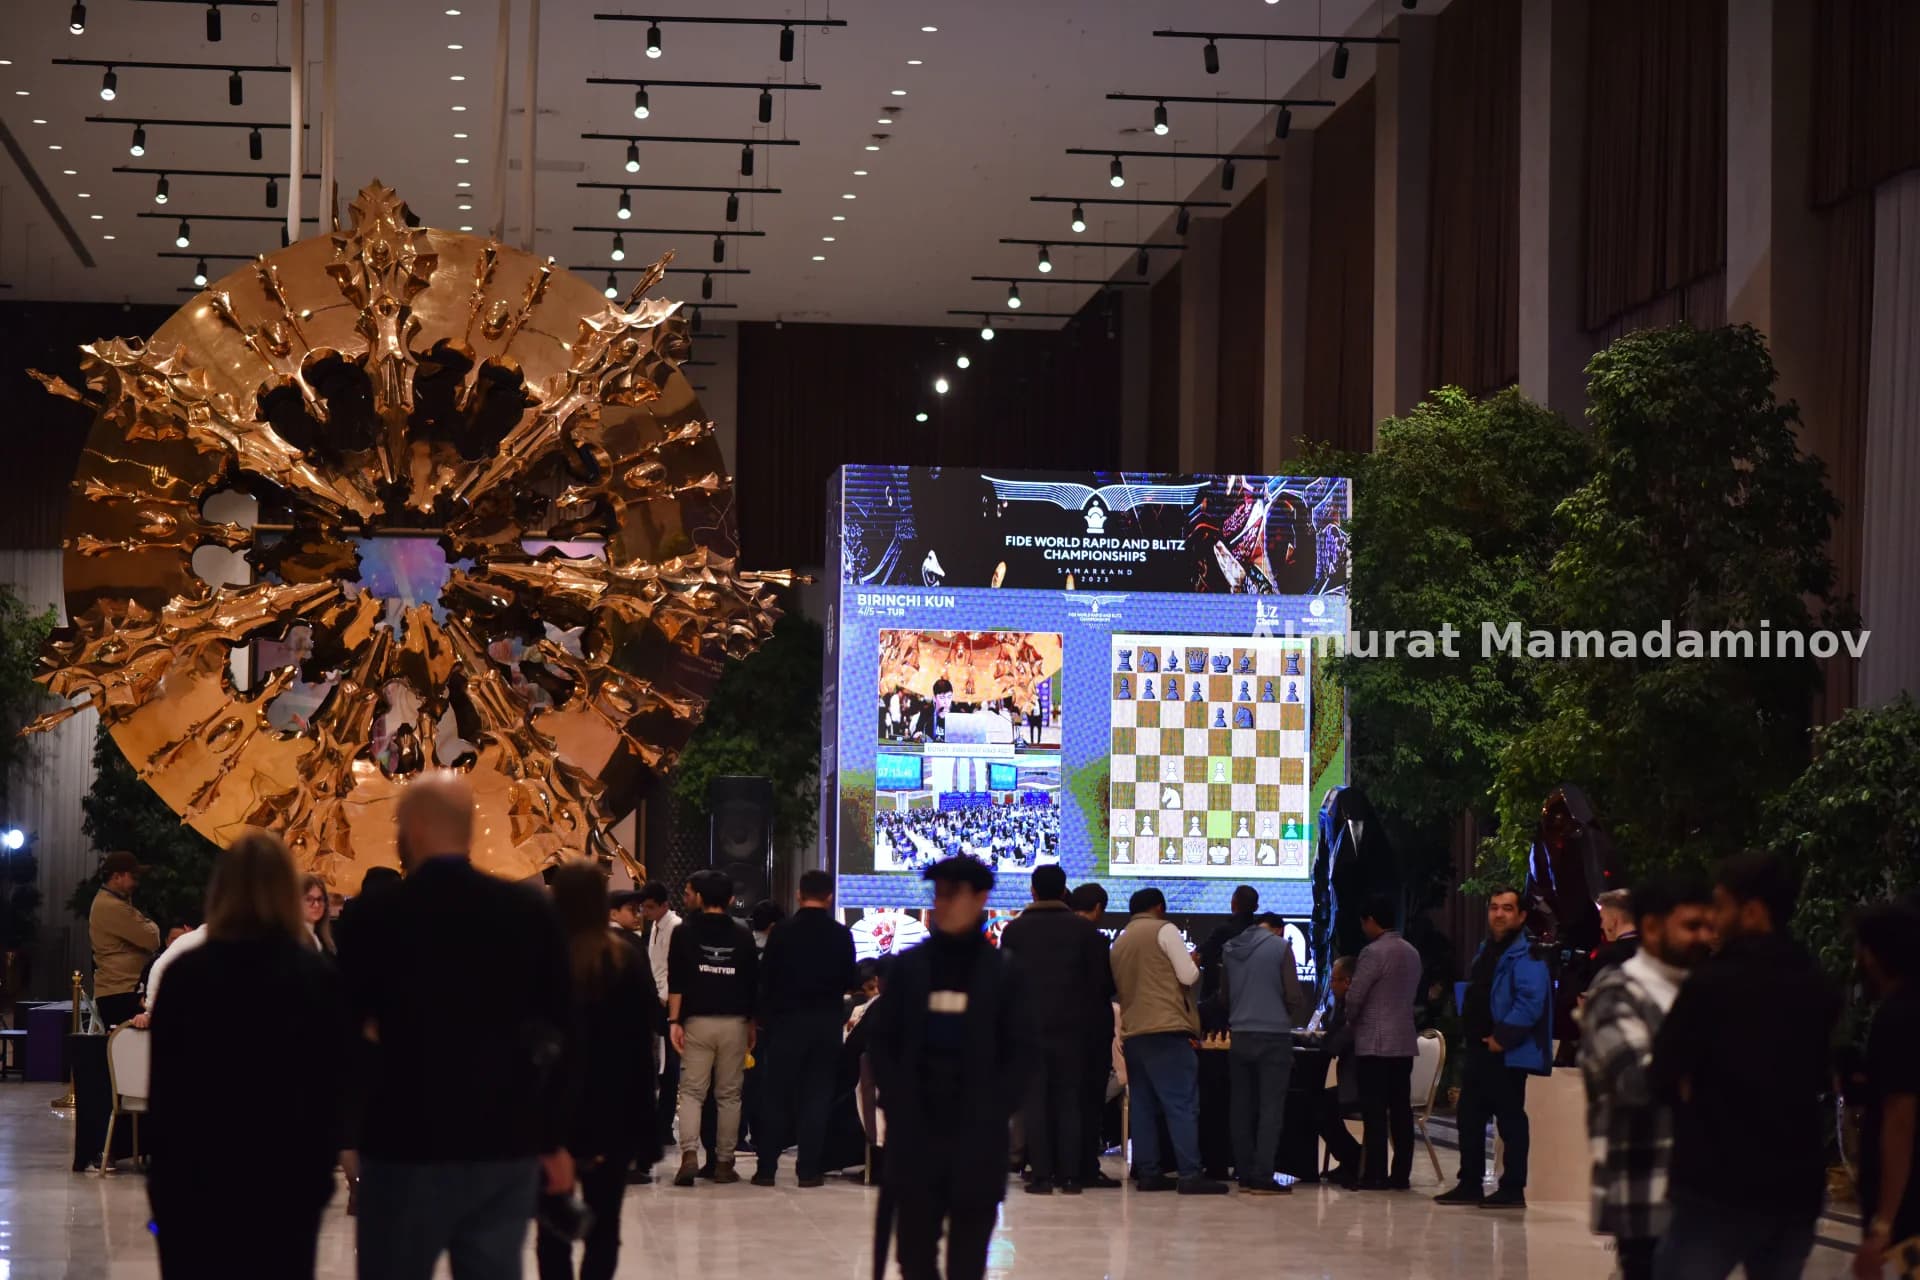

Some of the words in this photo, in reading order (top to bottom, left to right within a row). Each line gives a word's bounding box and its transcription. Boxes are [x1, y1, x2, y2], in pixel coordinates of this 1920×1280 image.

[1005, 536, 1032, 547] FIDE
[1034, 536, 1080, 548] WORLD
[1082, 538, 1120, 549] RAPID
[1122, 539, 1150, 550] AND
[1152, 540, 1185, 550] BLITZ
[1043, 549, 1146, 562] CHAMPIONSHIPS
[1057, 567, 1133, 576] SAMARKAND
[857, 593, 921, 607] BIRINCHI
[925, 595, 955, 608] KUN
[887, 608, 904, 617] TUR
